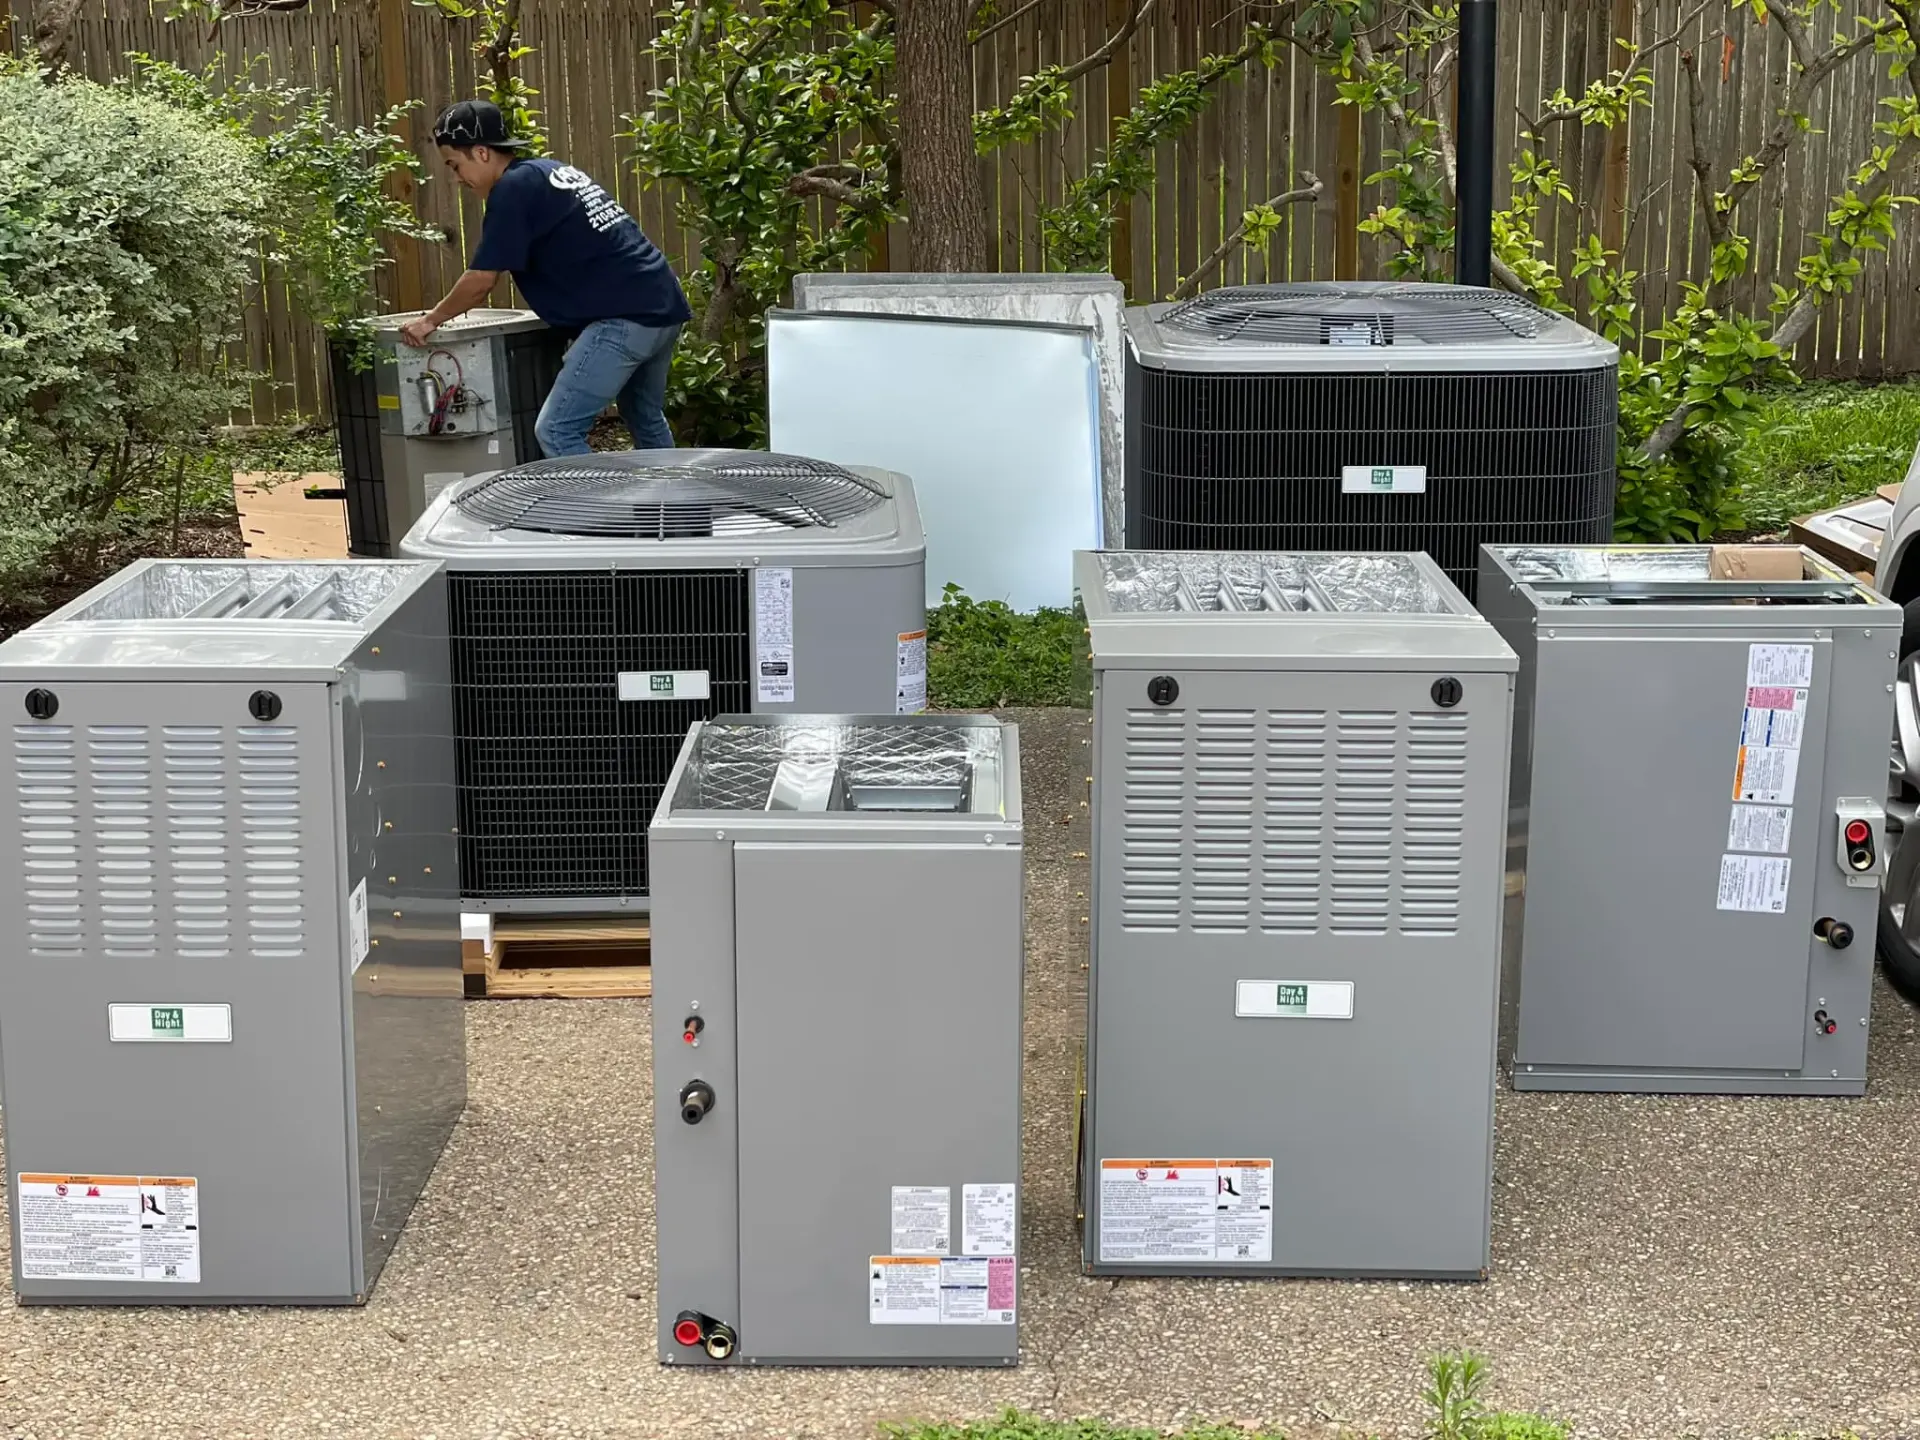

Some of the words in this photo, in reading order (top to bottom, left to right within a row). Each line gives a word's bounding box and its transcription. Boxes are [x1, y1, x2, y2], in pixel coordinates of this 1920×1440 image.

[1373, 470, 1385, 478] Day
[1280, 986, 1296, 997] Day
[1297, 986, 1304, 996] &
[1280, 995, 1304, 1005] Night
[154, 1010, 170, 1020] Day
[172, 1010, 179, 1019] &
[154, 1019, 180, 1029] Night
